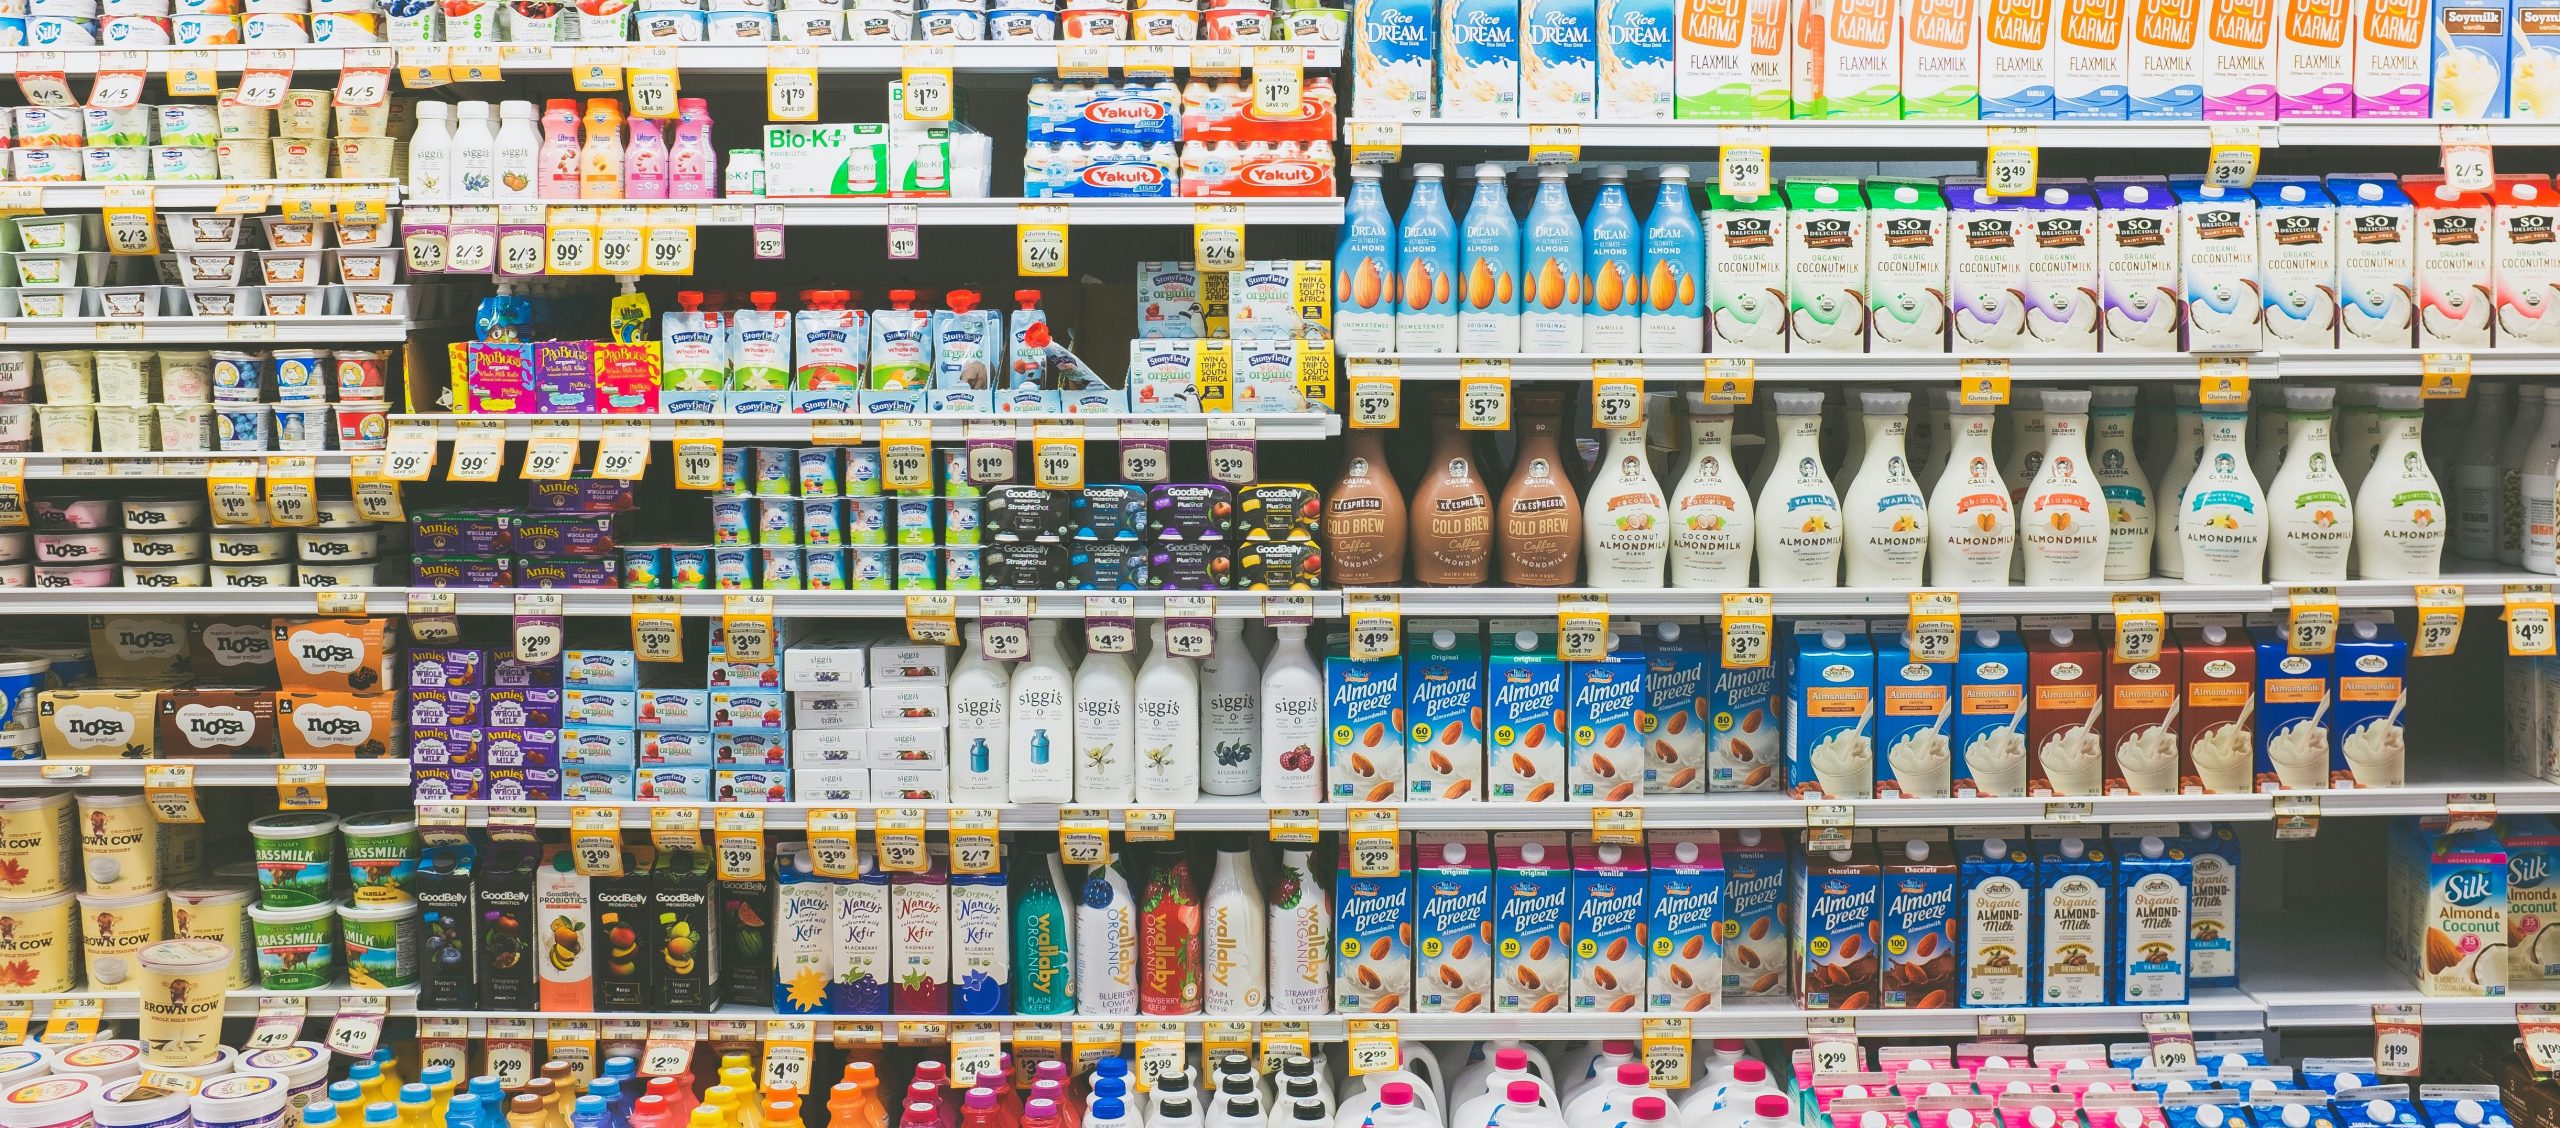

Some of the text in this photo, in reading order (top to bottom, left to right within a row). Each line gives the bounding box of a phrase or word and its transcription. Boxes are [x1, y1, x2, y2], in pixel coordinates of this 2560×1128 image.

[1381, 11, 1413, 26] Rice
[1624, 11, 1655, 26] Rice
[2448, 11, 2499, 24] Soymilk
[35, 22, 62, 43] Silk
[110, 23, 129, 40] Silk
[1367, 23, 1427, 44] DREAM
[1609, 25, 1670, 45] DREAM
[1689, 17, 1738, 40] KARMA
[1839, 16, 1888, 44] KARMA
[1690, 55, 1739, 71] FLAXMILK
[1840, 56, 1888, 71] FLAXMILK
[1996, 56, 2043, 72] FLAXMILK
[2294, 54, 2341, 70] FLAXMILK
[1097, 106, 1154, 121] Yakult
[1097, 168, 1154, 185] Yakult
[1253, 168, 1308, 183] Yakult
[200, 219, 230, 227] CHOBANI
[1737, 220, 1760, 231] SO
[2287, 217, 2310, 228] SO
[1351, 225, 1386, 237] DREAM
[557, 243, 583, 260] 99¢
[2283, 251, 2315, 259] ORGANIC
[1718, 261, 1780, 273] COCONUTMILK
[1960, 262, 2021, 273] COCONUTMILK
[2269, 259, 2329, 270] COCONUTMILK
[1247, 274, 1288, 286] Stonyfield
[1246, 290, 1289, 301] organic
[807, 331, 846, 342] Stonyfield
[1148, 354, 1189, 366] Stonyfield
[1148, 370, 1191, 381] organic
[2220, 427, 2231, 435] 40
[538, 481, 580, 496] Annie's
[1083, 488, 1128, 499] GoodBelly
[1168, 487, 1212, 498] GoodBelly
[1343, 500, 1380, 511] ESPRESSO
[1327, 518, 1384, 534] COLD BREW
[1509, 518, 1568, 534] COLD BREW
[1339, 539, 1370, 551] Coffee
[1599, 541, 1667, 550] ALMONDMILK
[2028, 534, 2098, 544] ALMONDMILK
[2187, 534, 2258, 544] ALMONDMILK
[46, 542, 87, 557] noosa
[1511, 552, 1568, 568] ALMONDMILK
[302, 644, 354, 662] noosa
[412, 649, 446, 663] Annie's
[1334, 673, 1397, 705] Almond
[1575, 673, 1641, 705] Almond
[2345, 682, 2396, 691] Almondmilk
[1812, 691, 1865, 701] Almondmilk
[2040, 690, 2093, 699] Almondmilk
[957, 698, 1001, 716] siggi's
[1347, 693, 1391, 720] Breeze
[1590, 695, 1634, 721] Breeze
[190, 718, 245, 735] noosa
[1337, 730, 1349, 739] 60
[1580, 731, 1591, 739] 80
[2444, 874, 2493, 902] Silk
[419, 892, 467, 903] GoodBelly
[539, 896, 588, 904] PROBIOTICS
[656, 893, 705, 903] GoodBelly
[1342, 888, 1406, 917] Almond
[1812, 886, 1876, 917] Almond
[2053, 897, 2098, 906] Organic
[1356, 908, 1400, 931] Breeze
[1825, 906, 1870, 930] Breeze
[2440, 908, 2492, 920] Almond
[2060, 919, 2091, 930] Milk
[2442, 920, 2500, 933] Coconut
[257, 931, 323, 946] GRASSMILK
[792, 925, 823, 942] Kefir
[964, 927, 994, 944] Kefir
[2463, 936, 2476, 945] 35
[1027, 915, 1039, 980] ORGANIC
[1344, 943, 1357, 952] 30
[1889, 939, 1906, 947] 100
[1037, 913, 1052, 994] wallaby
[1099, 990, 1136, 1000] BLUEBERRY
[144, 1000, 219, 1015] BROWN COW
[1102, 999, 1134, 1008] LOWFAT
